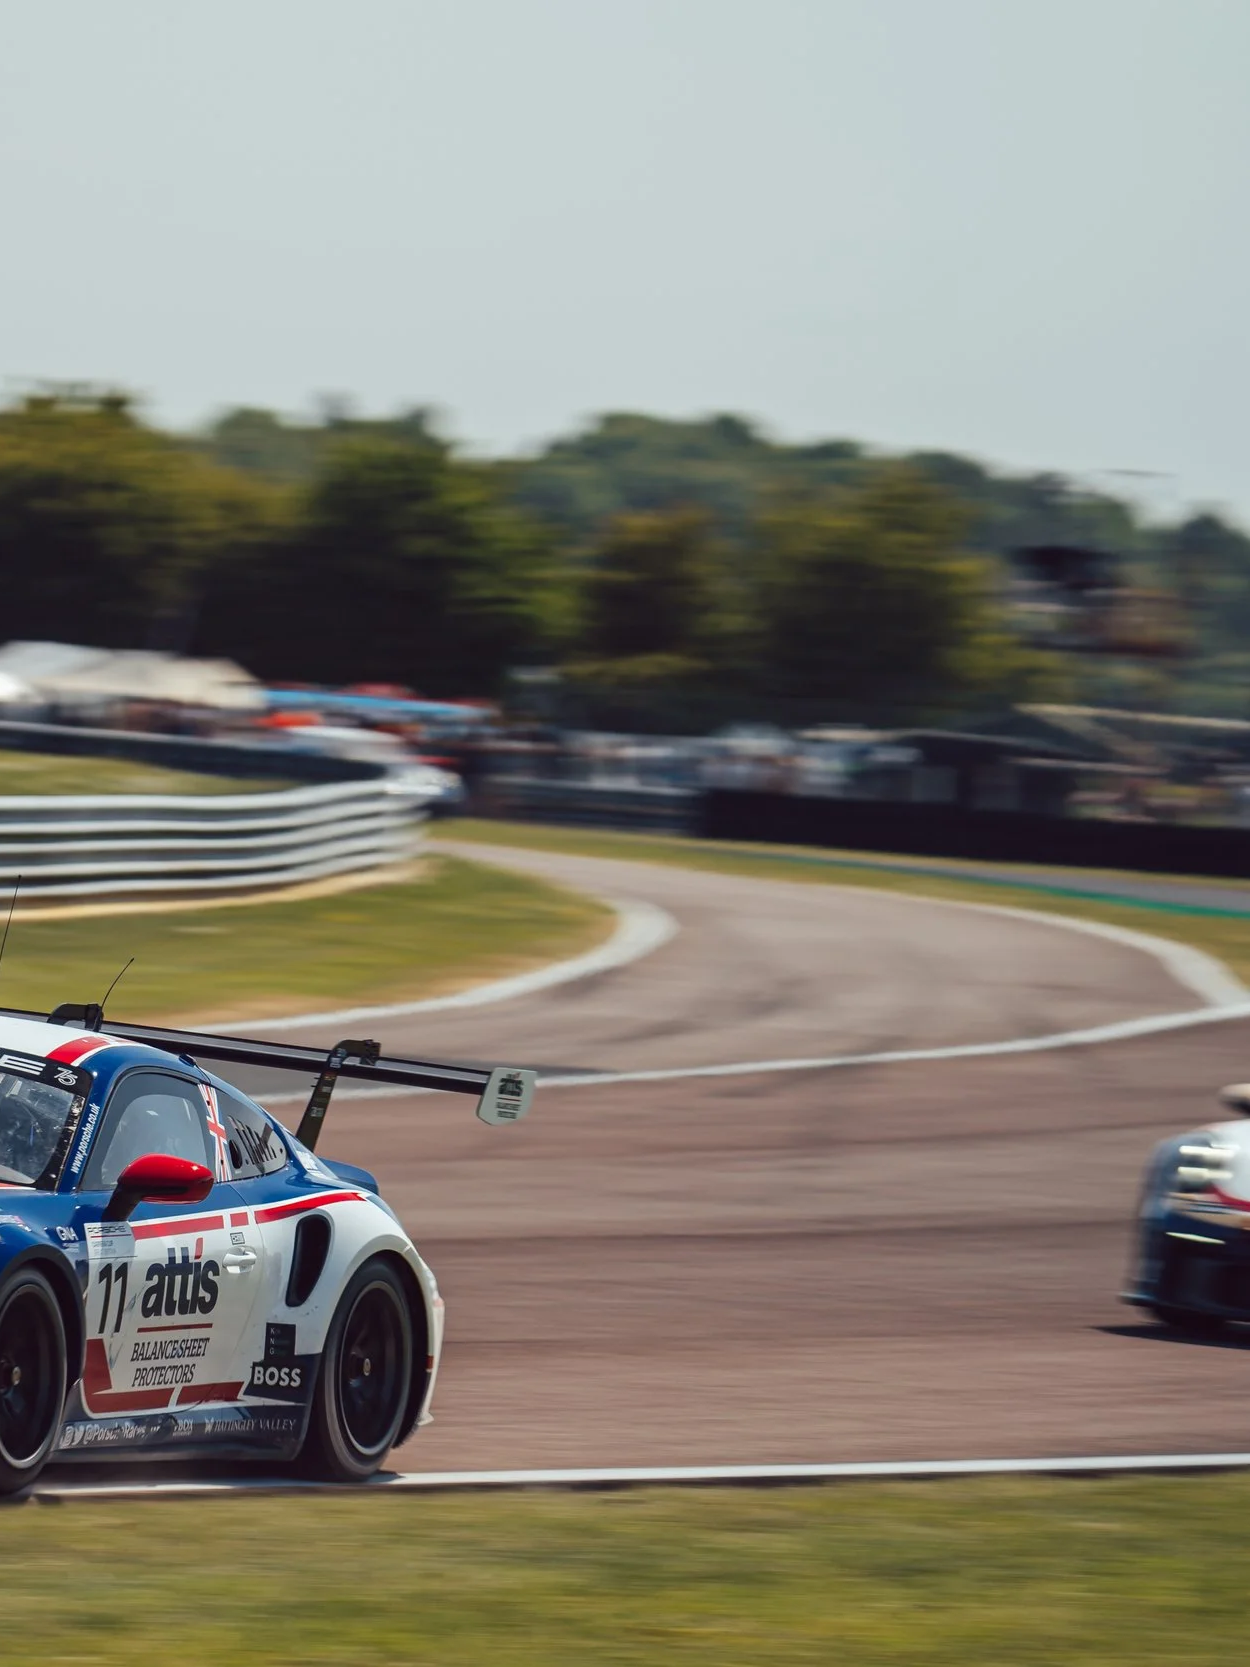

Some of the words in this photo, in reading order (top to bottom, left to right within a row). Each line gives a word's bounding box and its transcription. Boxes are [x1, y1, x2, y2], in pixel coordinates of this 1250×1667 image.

[53, 1067, 77, 1086] 75
[71, 1102, 101, 1174] www.porsche.co.uk
[141, 1237, 220, 1319] attis
[98, 1262, 129, 1335] 11
[130, 1340, 179, 1362] BALANCE
[176, 1337, 210, 1359] SHEET
[132, 1363, 196, 1387] PROTECTORS
[253, 1366, 301, 1388] BOSS
[259, 1418, 297, 1432] VALLEY
